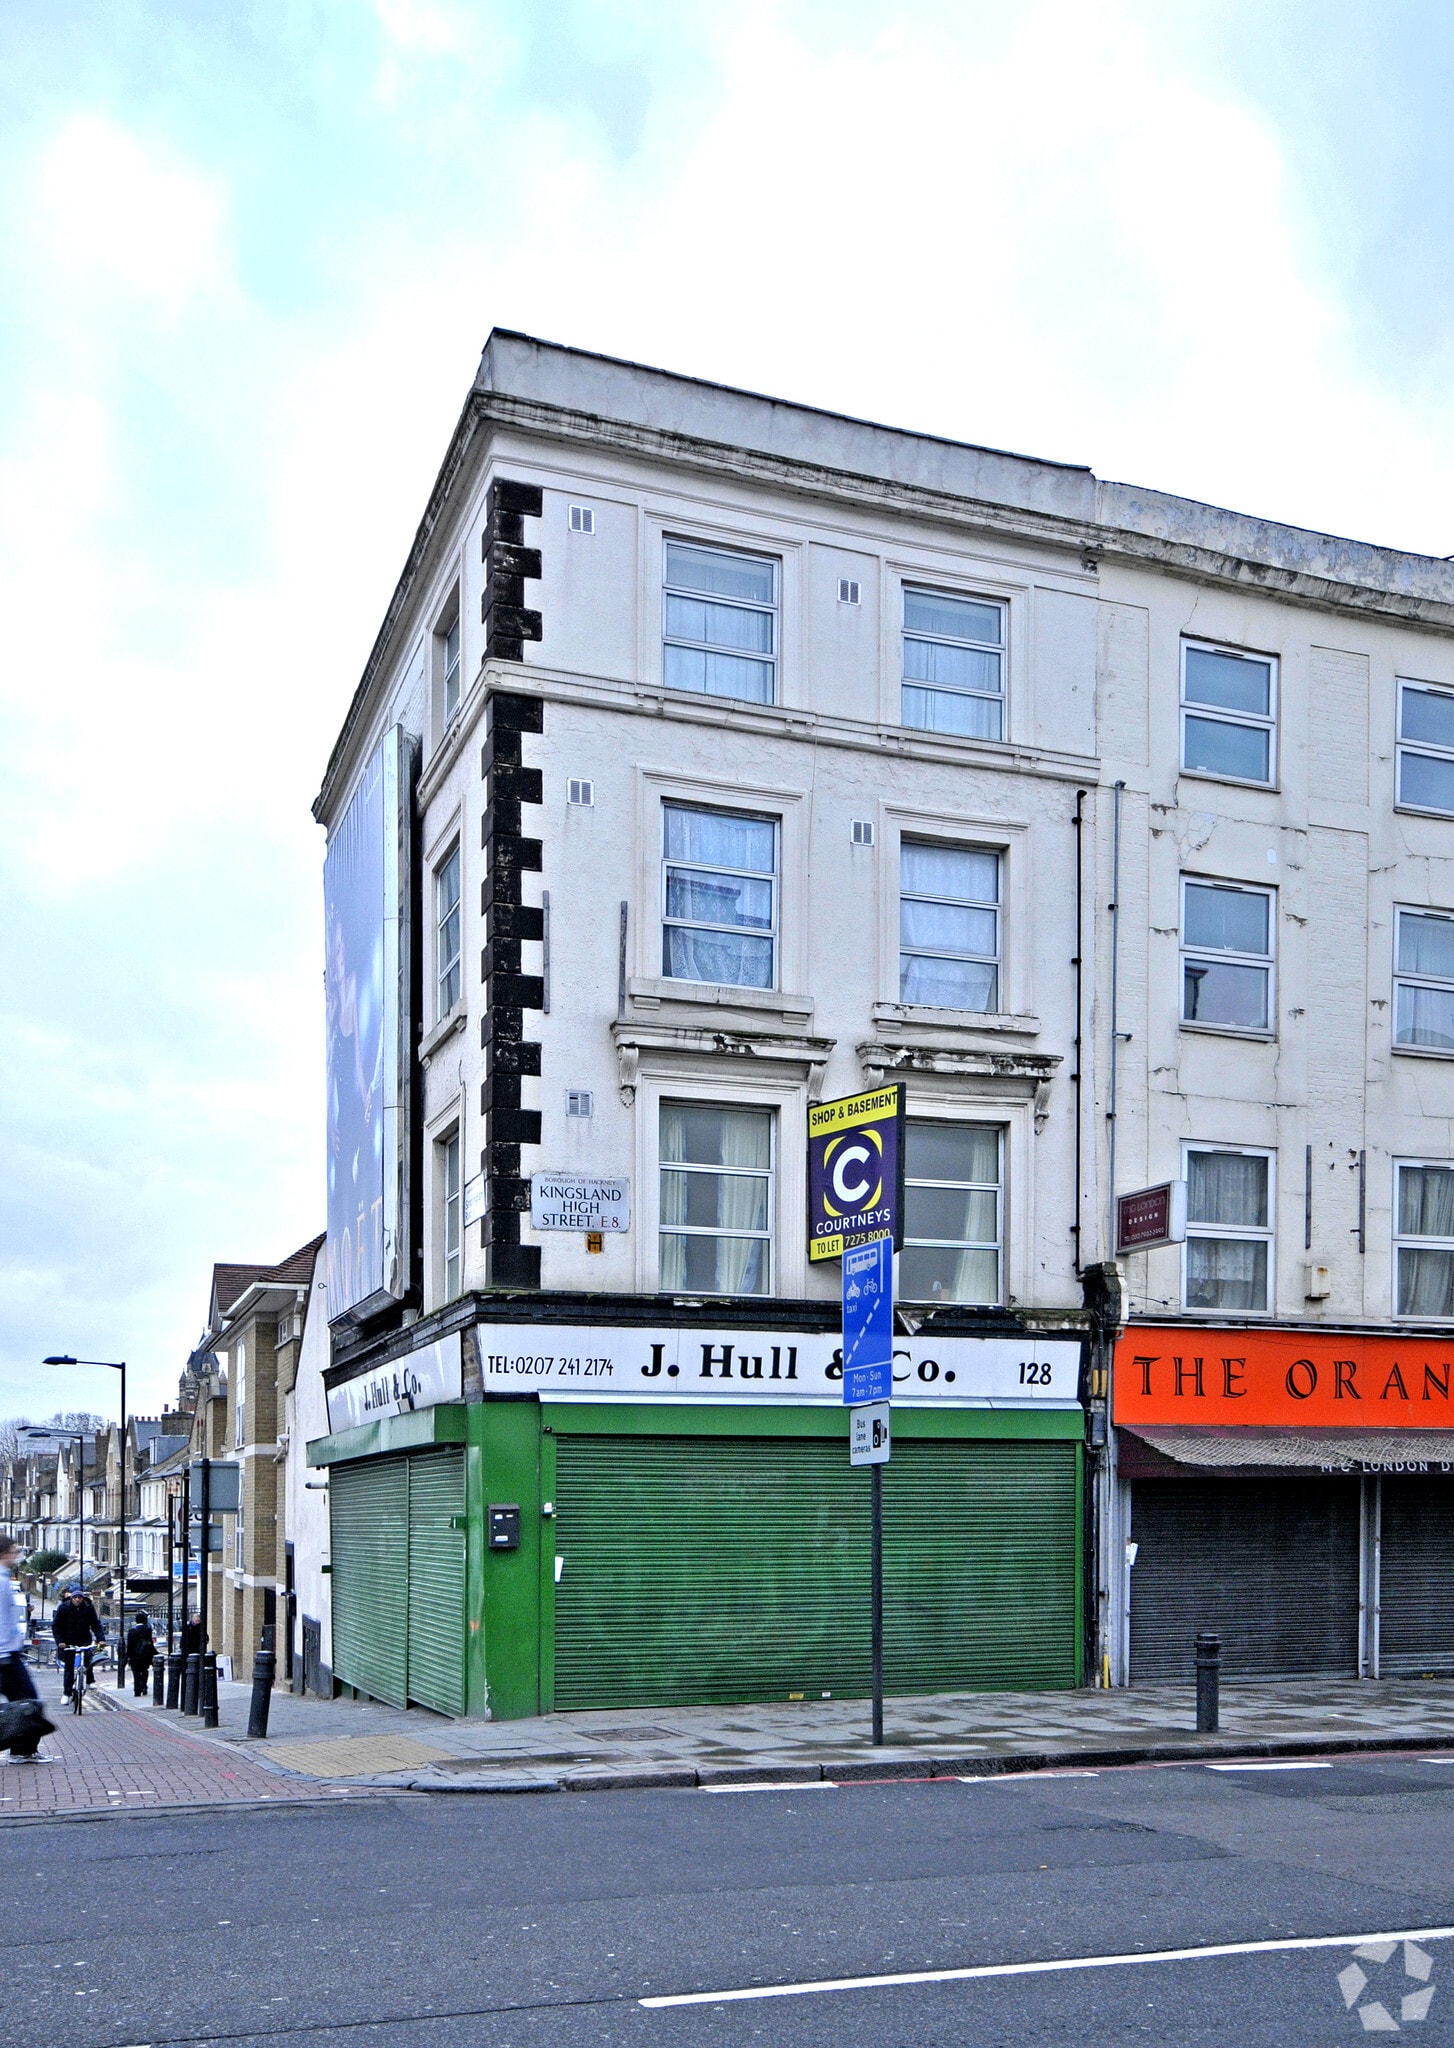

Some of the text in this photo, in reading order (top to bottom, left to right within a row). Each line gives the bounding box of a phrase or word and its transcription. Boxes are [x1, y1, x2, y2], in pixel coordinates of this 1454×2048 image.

[812, 1091, 897, 1126] SHOP & BASEMENT
[540, 1186, 621, 1201] KINGSLAND
[562, 1201, 600, 1214] HIGH
[542, 1213, 595, 1228] STREET.
[816, 1208, 891, 1235] COURTNEYS
[1128, 1212, 1159, 1225] DESIGN
[845, 1228, 891, 1247] 7275 8000
[817, 1239, 840, 1254] TO LET
[846, 1302, 858, 1314] taxi
[558, 1357, 580, 1376] 241
[584, 1358, 613, 1377] 2174
[641, 1344, 680, 1377] J.
[699, 1344, 798, 1379] Hull
[1018, 1362, 1052, 1385] 128
[1132, 1355, 1450, 1401] THE ORAN
[370, 1376, 390, 1409] Hull
[393, 1373, 401, 1401] &
[403, 1367, 421, 1395] Co.
[856, 1419, 866, 1429] Bus
[855, 1432, 866, 1442] lane
[852, 1445, 871, 1454] cameras
[1362, 1461, 1428, 1472] LONDON
[1441, 1462, 1451, 1472] D
